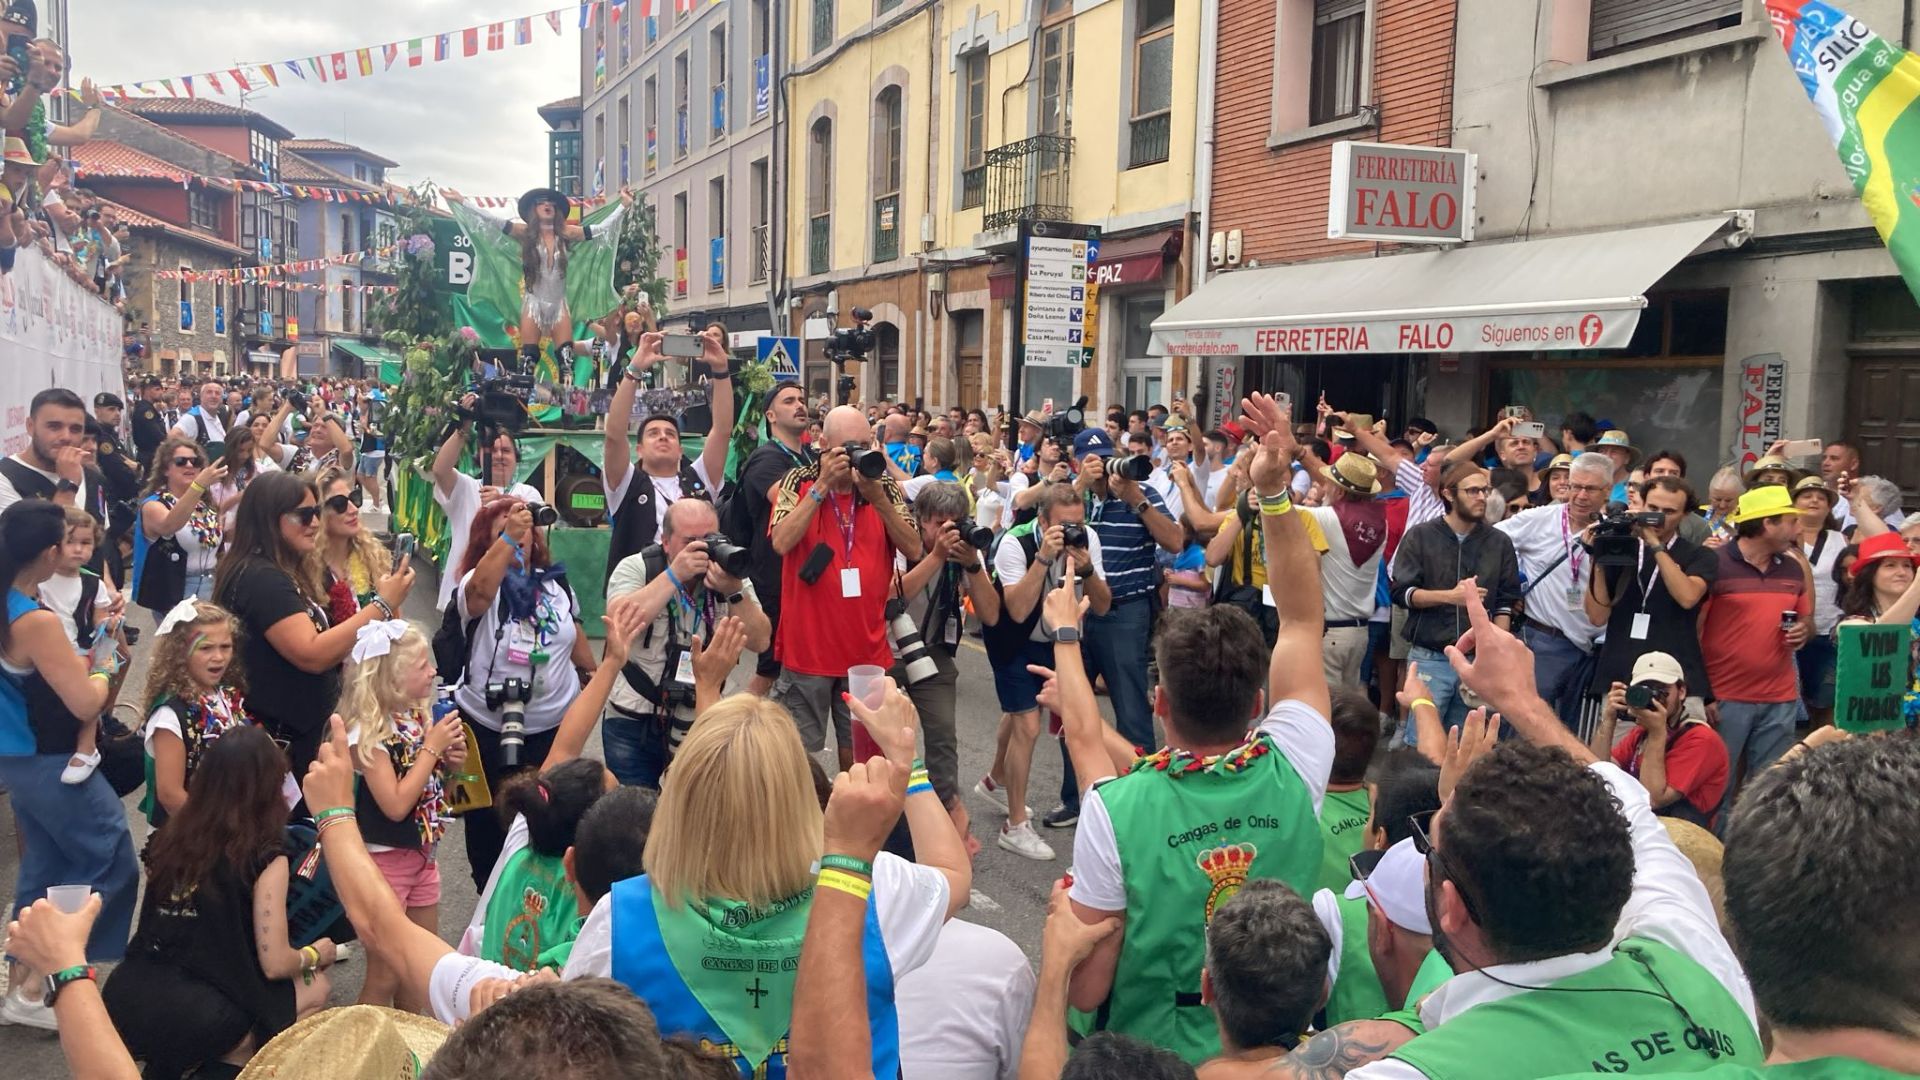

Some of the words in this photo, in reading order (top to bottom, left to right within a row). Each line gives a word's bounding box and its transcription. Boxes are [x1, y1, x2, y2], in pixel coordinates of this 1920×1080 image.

[1356, 154, 1457, 185] FERRETERÍA
[1354, 188, 1457, 231] FALO
[1031, 245, 1073, 254] ayuntamiento
[1028, 305, 1056, 313] Quintana
[1256, 326, 1369, 352] FERRETERIA
[1399, 323, 1454, 350] FALO
[1554, 325, 1574, 341] en
[1763, 364, 1783, 456] FERRETE
[1167, 822, 1219, 849] Cangas
[1224, 816, 1241, 830] de
[1247, 814, 1279, 829] Onís
[702, 957, 753, 972] CANGAS
[758, 960, 778, 973] DE
[782, 956, 801, 971] ON
[1630, 1031, 1676, 1062] DE
